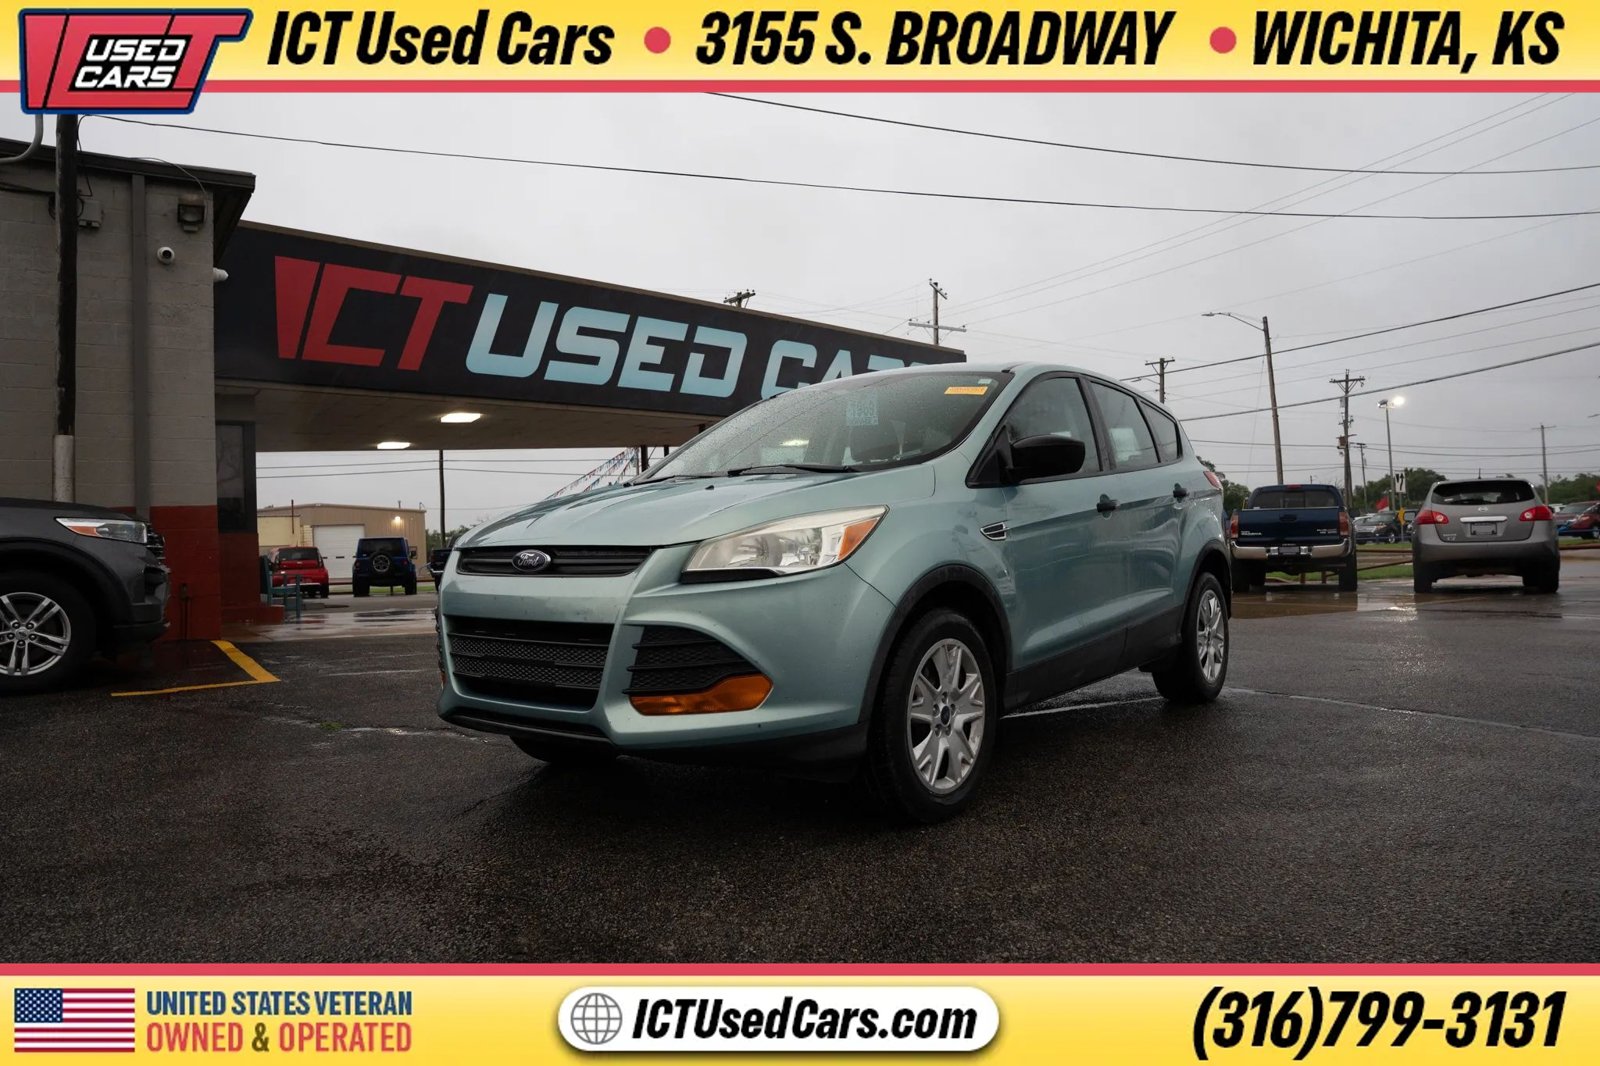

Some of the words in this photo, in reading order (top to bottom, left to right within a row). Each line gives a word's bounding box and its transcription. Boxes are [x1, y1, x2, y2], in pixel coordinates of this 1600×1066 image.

[275, 256, 473, 371] ICT
[465, 293, 748, 399] USED
[517, 552, 540, 567] Ford
